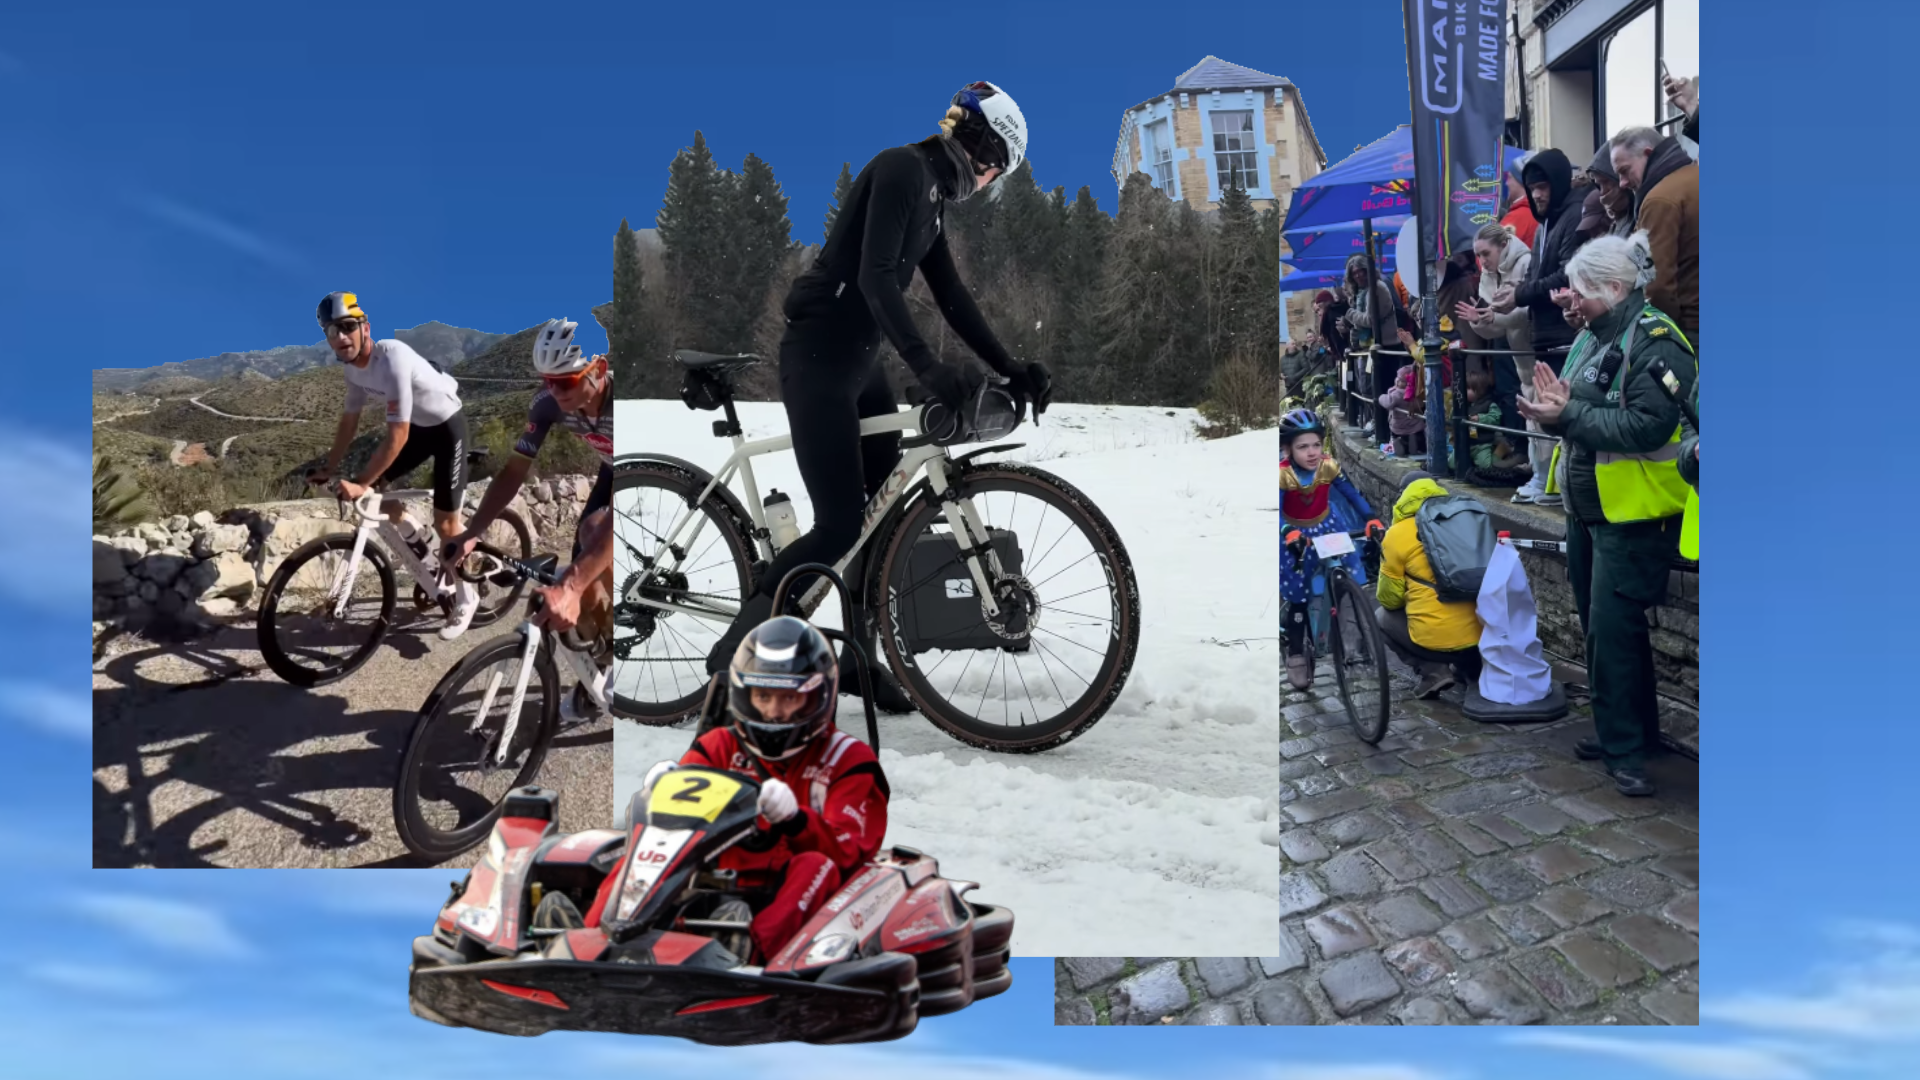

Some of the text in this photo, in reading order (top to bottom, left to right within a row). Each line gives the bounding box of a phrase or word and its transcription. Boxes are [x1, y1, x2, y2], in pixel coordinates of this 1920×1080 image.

[1478, 22, 1499, 81] MADE
[450, 439, 463, 490] CANYON
[863, 469, 907, 531] RKS
[671, 776, 711, 804] 2
